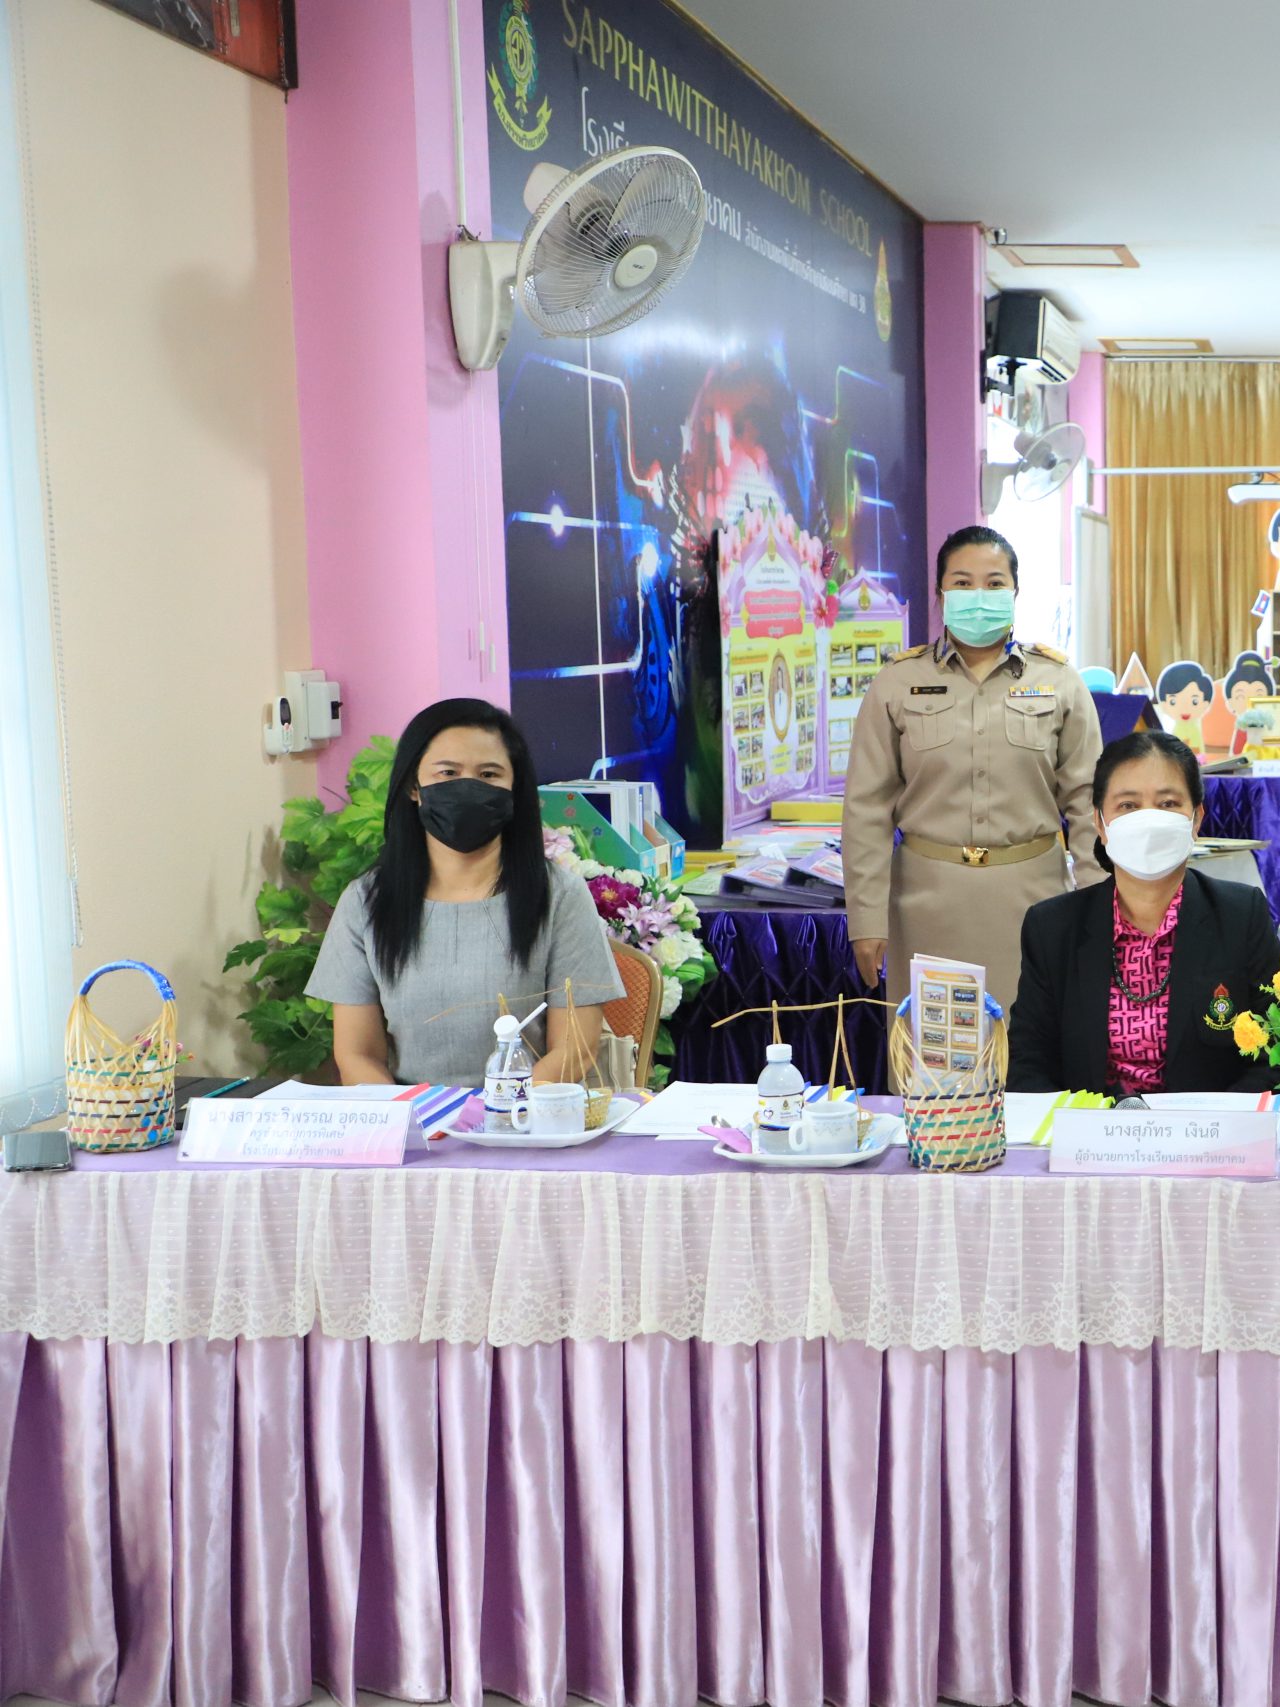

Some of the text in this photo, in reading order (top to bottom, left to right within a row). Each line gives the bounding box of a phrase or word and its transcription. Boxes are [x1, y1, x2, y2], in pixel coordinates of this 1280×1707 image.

[563, 0, 872, 257] SAPPHAWITTHAYAKHOM SCHOOL
[1104, 1120, 1220, 1143] นางสุภัทร เงินดี
